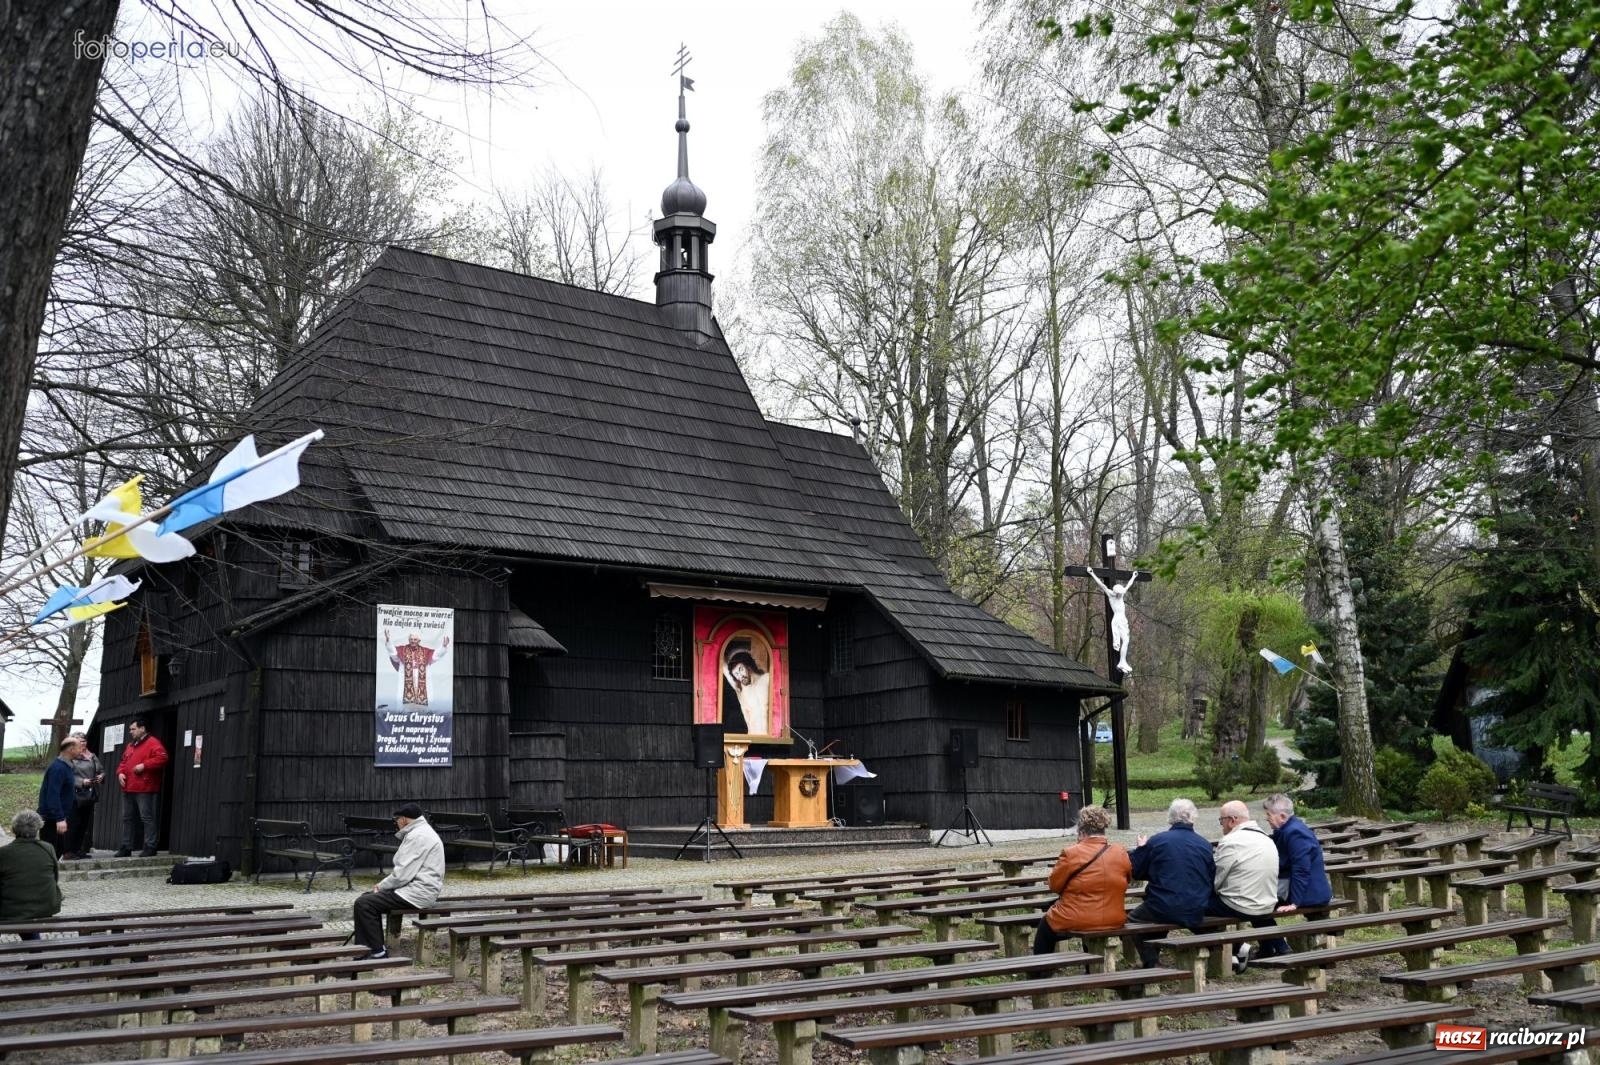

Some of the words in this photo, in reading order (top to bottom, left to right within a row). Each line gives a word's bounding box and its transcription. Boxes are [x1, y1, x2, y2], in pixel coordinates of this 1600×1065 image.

[431, 610, 454, 619] wierze!
[383, 618, 393, 626] Nie
[384, 712, 408, 722] Jezus
[410, 712, 445, 725] Chrystus
[391, 724, 405, 734] jest
[405, 725, 438, 735] naprawdę
[376, 735, 398, 745] Drogą,
[399, 735, 425, 744] Prawdą
[429, 733, 452, 745] Życiem
[411, 744, 427, 755] Jego
[418, 757, 440, 765] Benedykt
